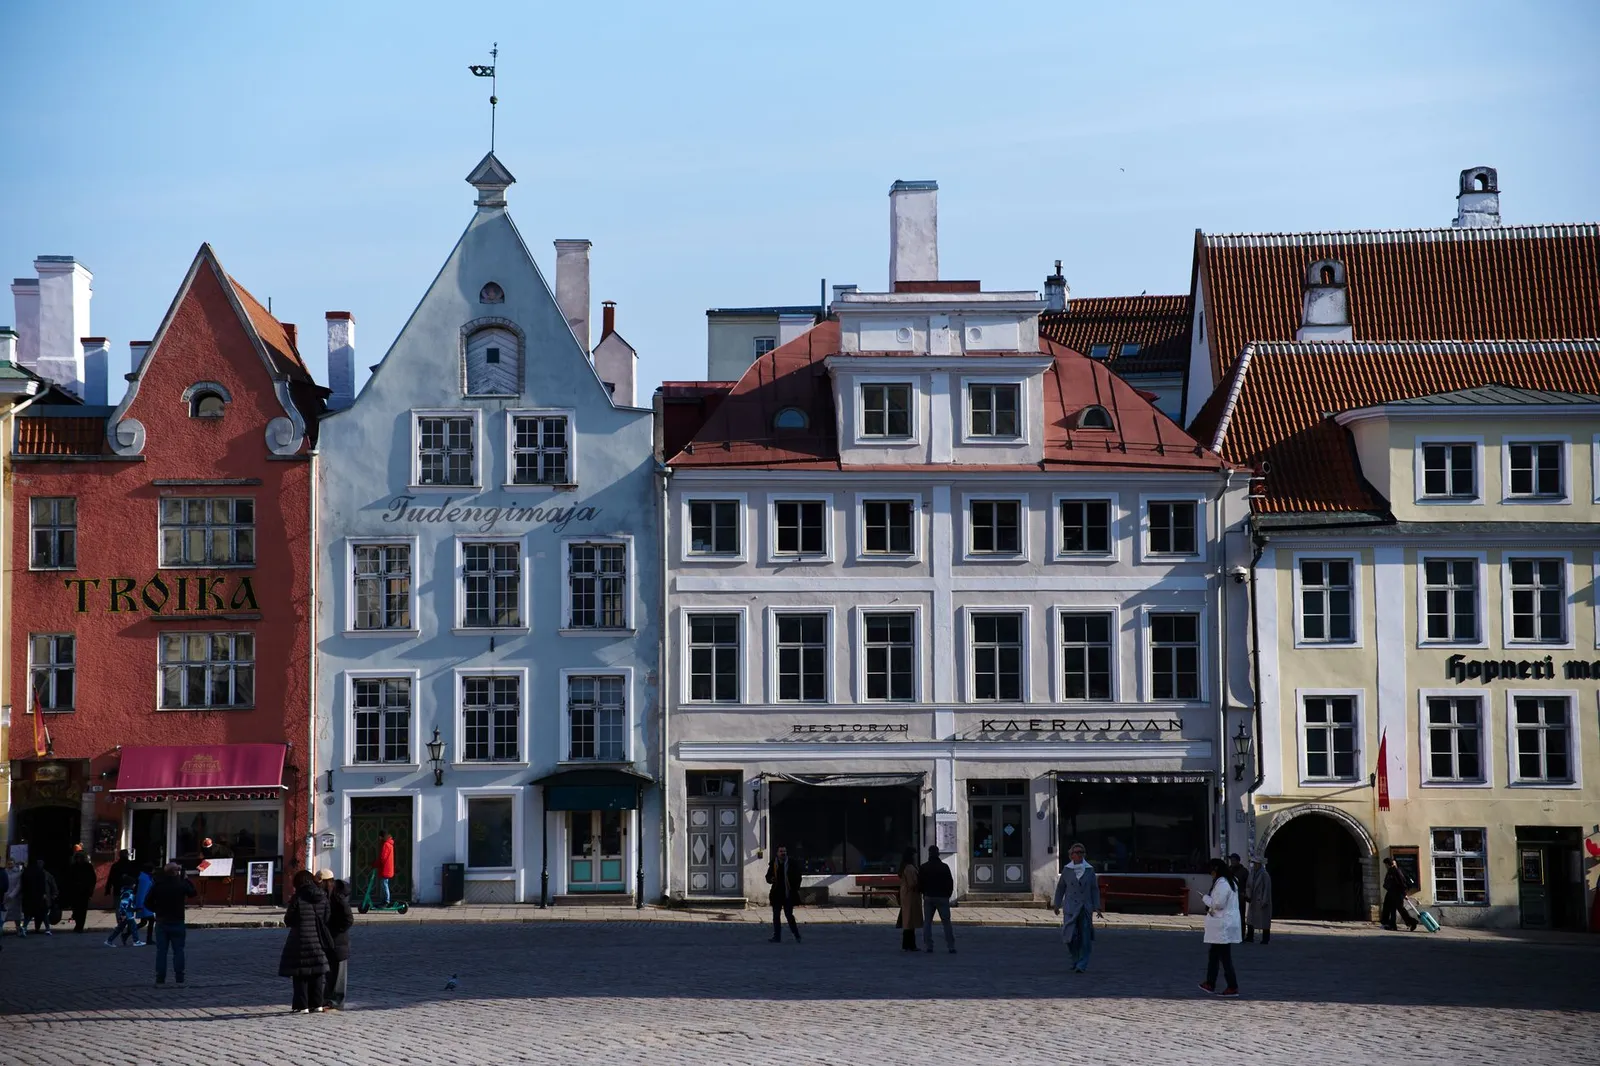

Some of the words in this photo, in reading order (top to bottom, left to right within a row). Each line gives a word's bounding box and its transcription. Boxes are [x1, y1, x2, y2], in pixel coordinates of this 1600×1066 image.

[382, 496, 602, 533] Tudengimaja
[64, 572, 260, 615] TROIKA
[793, 724, 909, 733] RESTORAN
[981, 719, 1183, 732] KAERAJAAN
